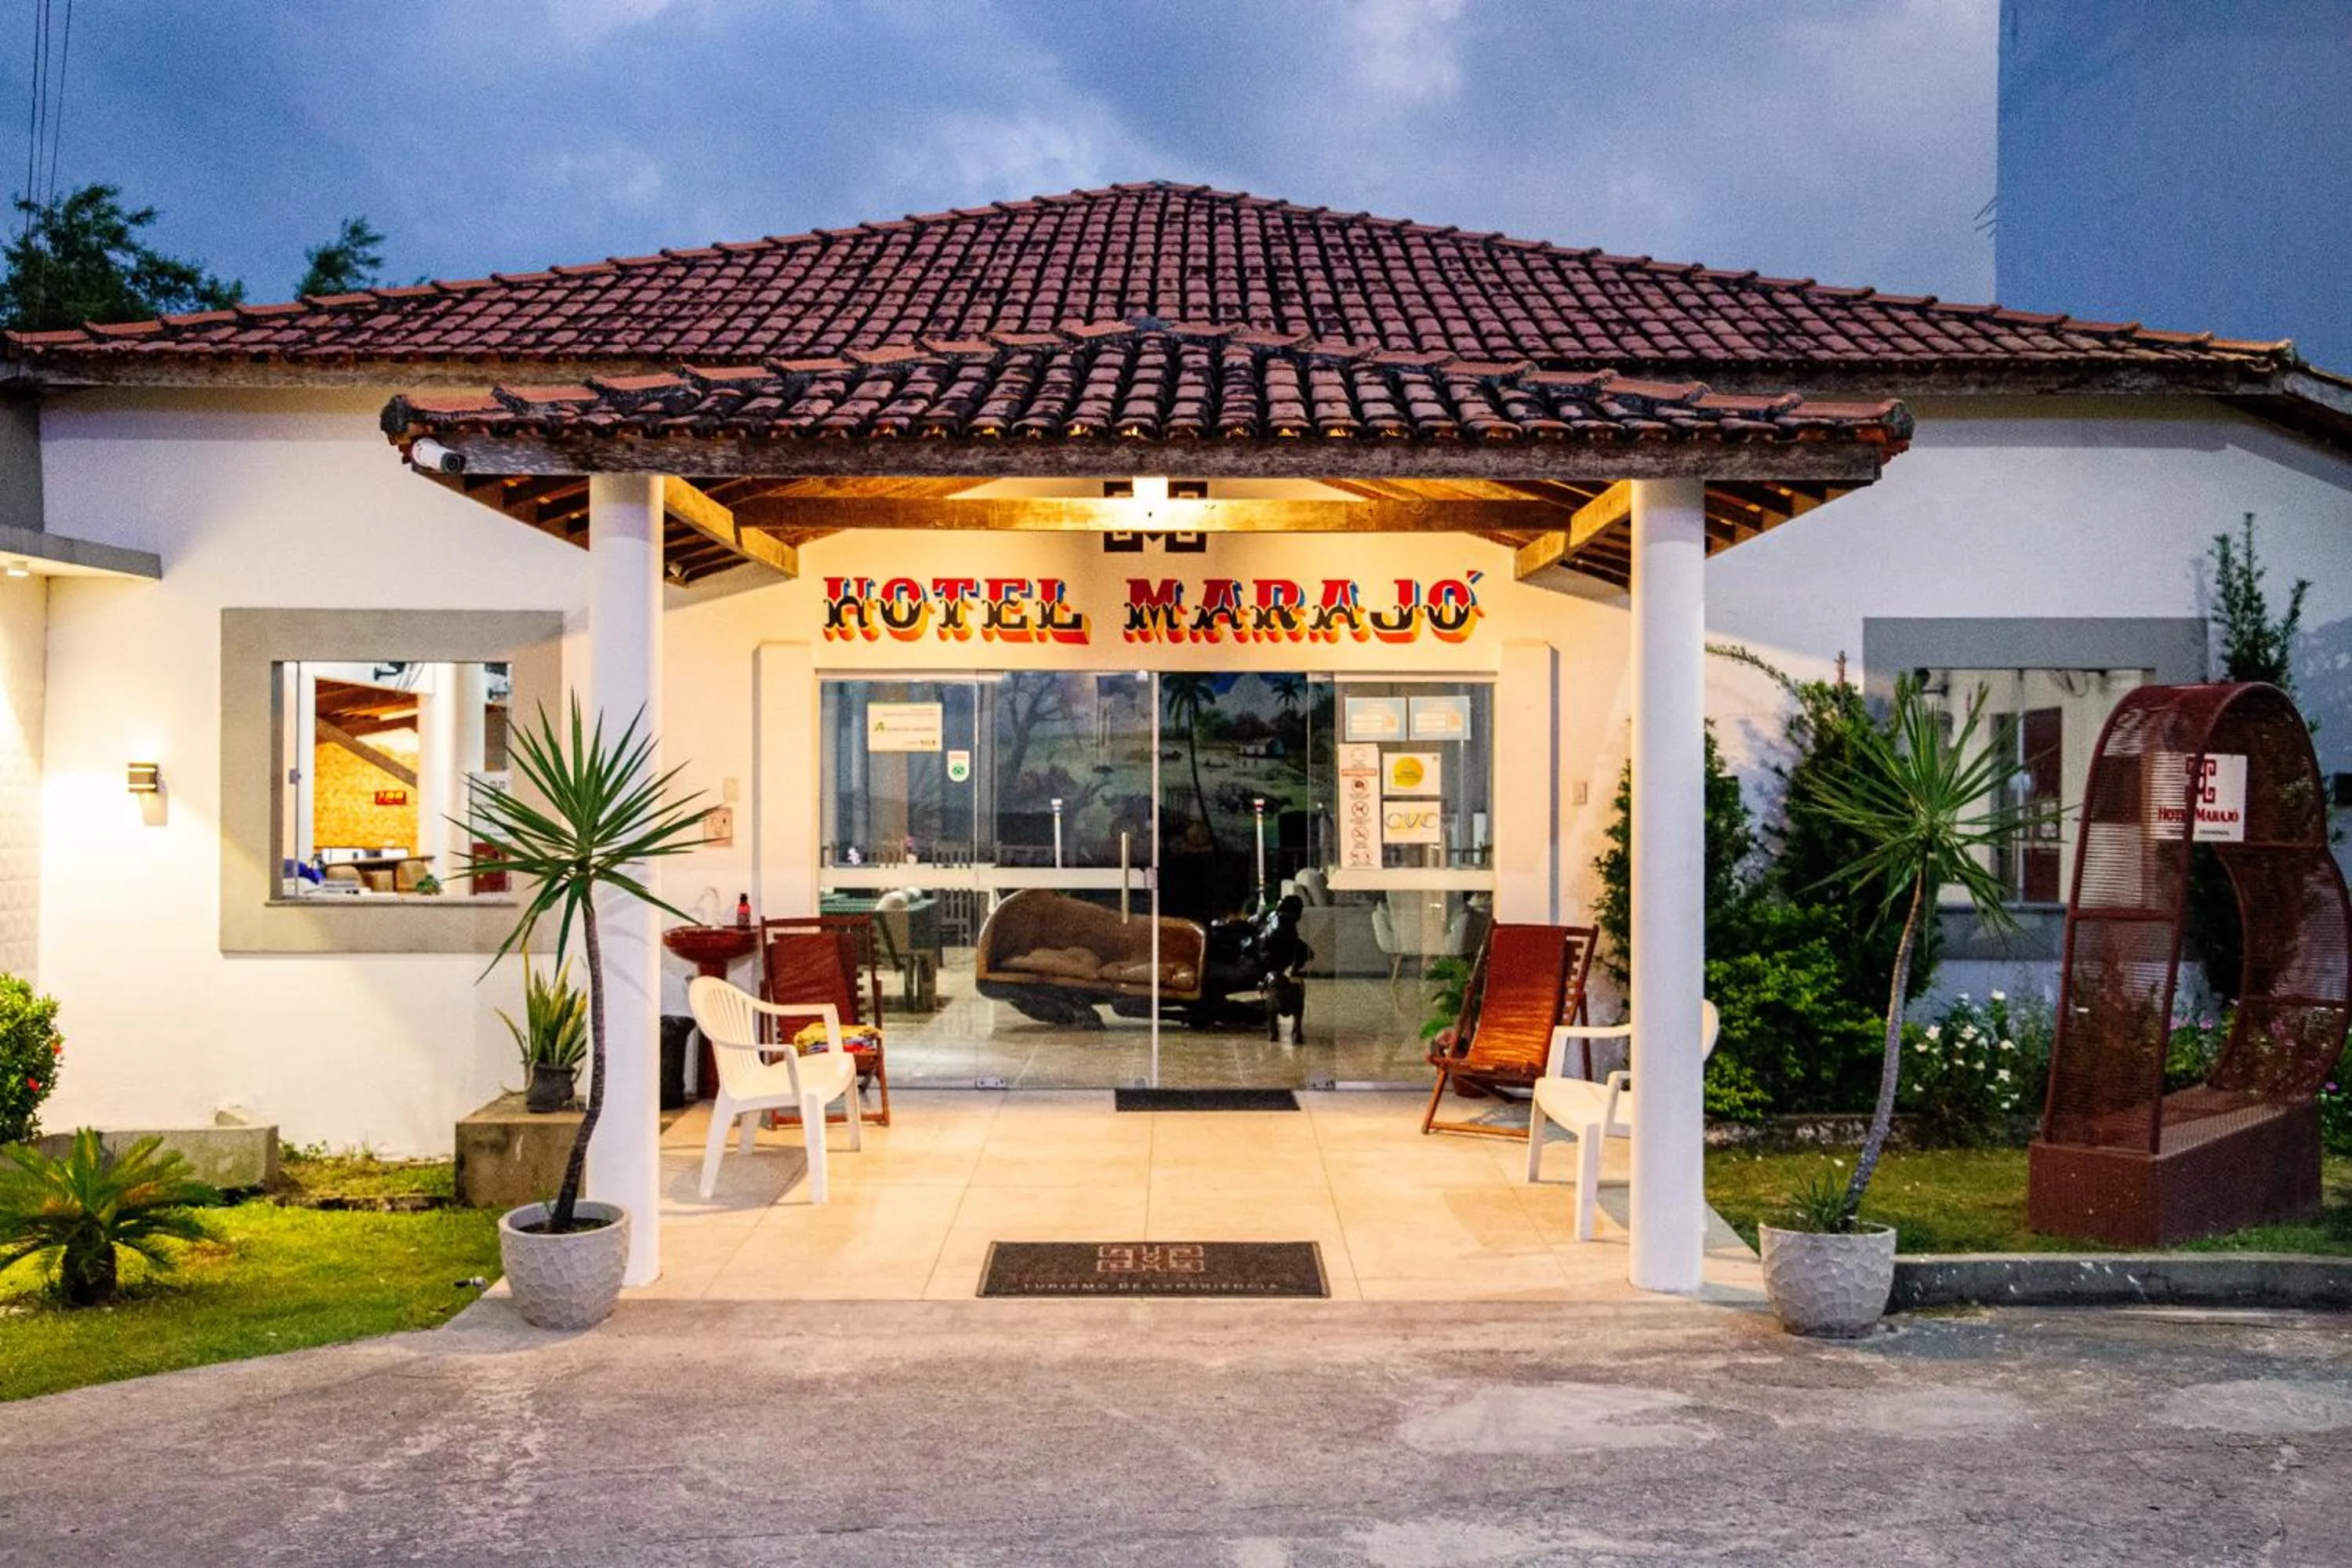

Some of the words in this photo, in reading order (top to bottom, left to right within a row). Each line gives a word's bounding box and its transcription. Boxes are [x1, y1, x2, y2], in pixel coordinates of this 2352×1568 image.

[822, 575, 1091, 644] HOTEL
[1122, 570, 1484, 644] MARAJÓ
[1385, 811, 1438, 829] CVC
